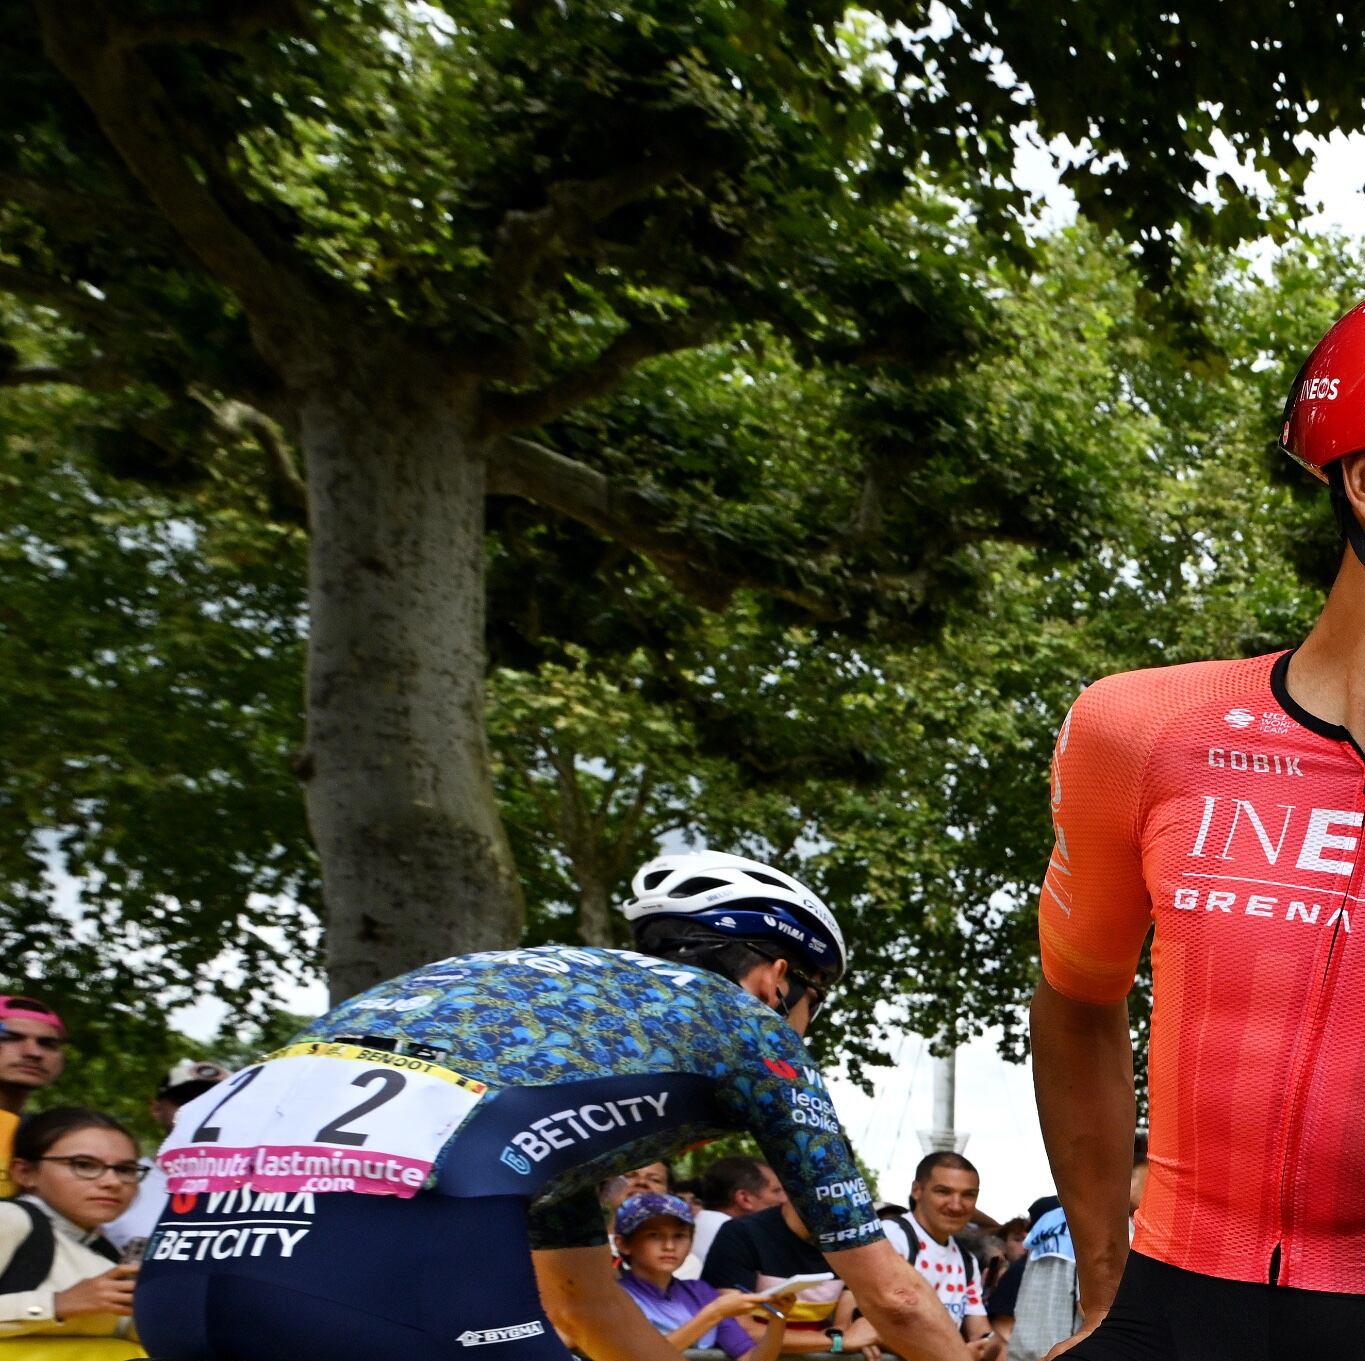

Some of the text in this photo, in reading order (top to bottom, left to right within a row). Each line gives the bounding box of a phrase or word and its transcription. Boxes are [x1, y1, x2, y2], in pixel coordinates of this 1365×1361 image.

[1300, 378, 1341, 402] INEOS
[1208, 748, 1304, 777] GOBIK
[777, 920, 806, 943] VISMA
[191, 1065, 407, 1147] 2 2
[512, 1091, 669, 1165] BETCITY
[255, 1148, 425, 1187] lastminute
[205, 1183, 316, 1215] VISMA
[301, 1178, 355, 1193] .com
[152, 1228, 310, 1261] BETCITY
[483, 1323, 542, 1343] BYGMA
